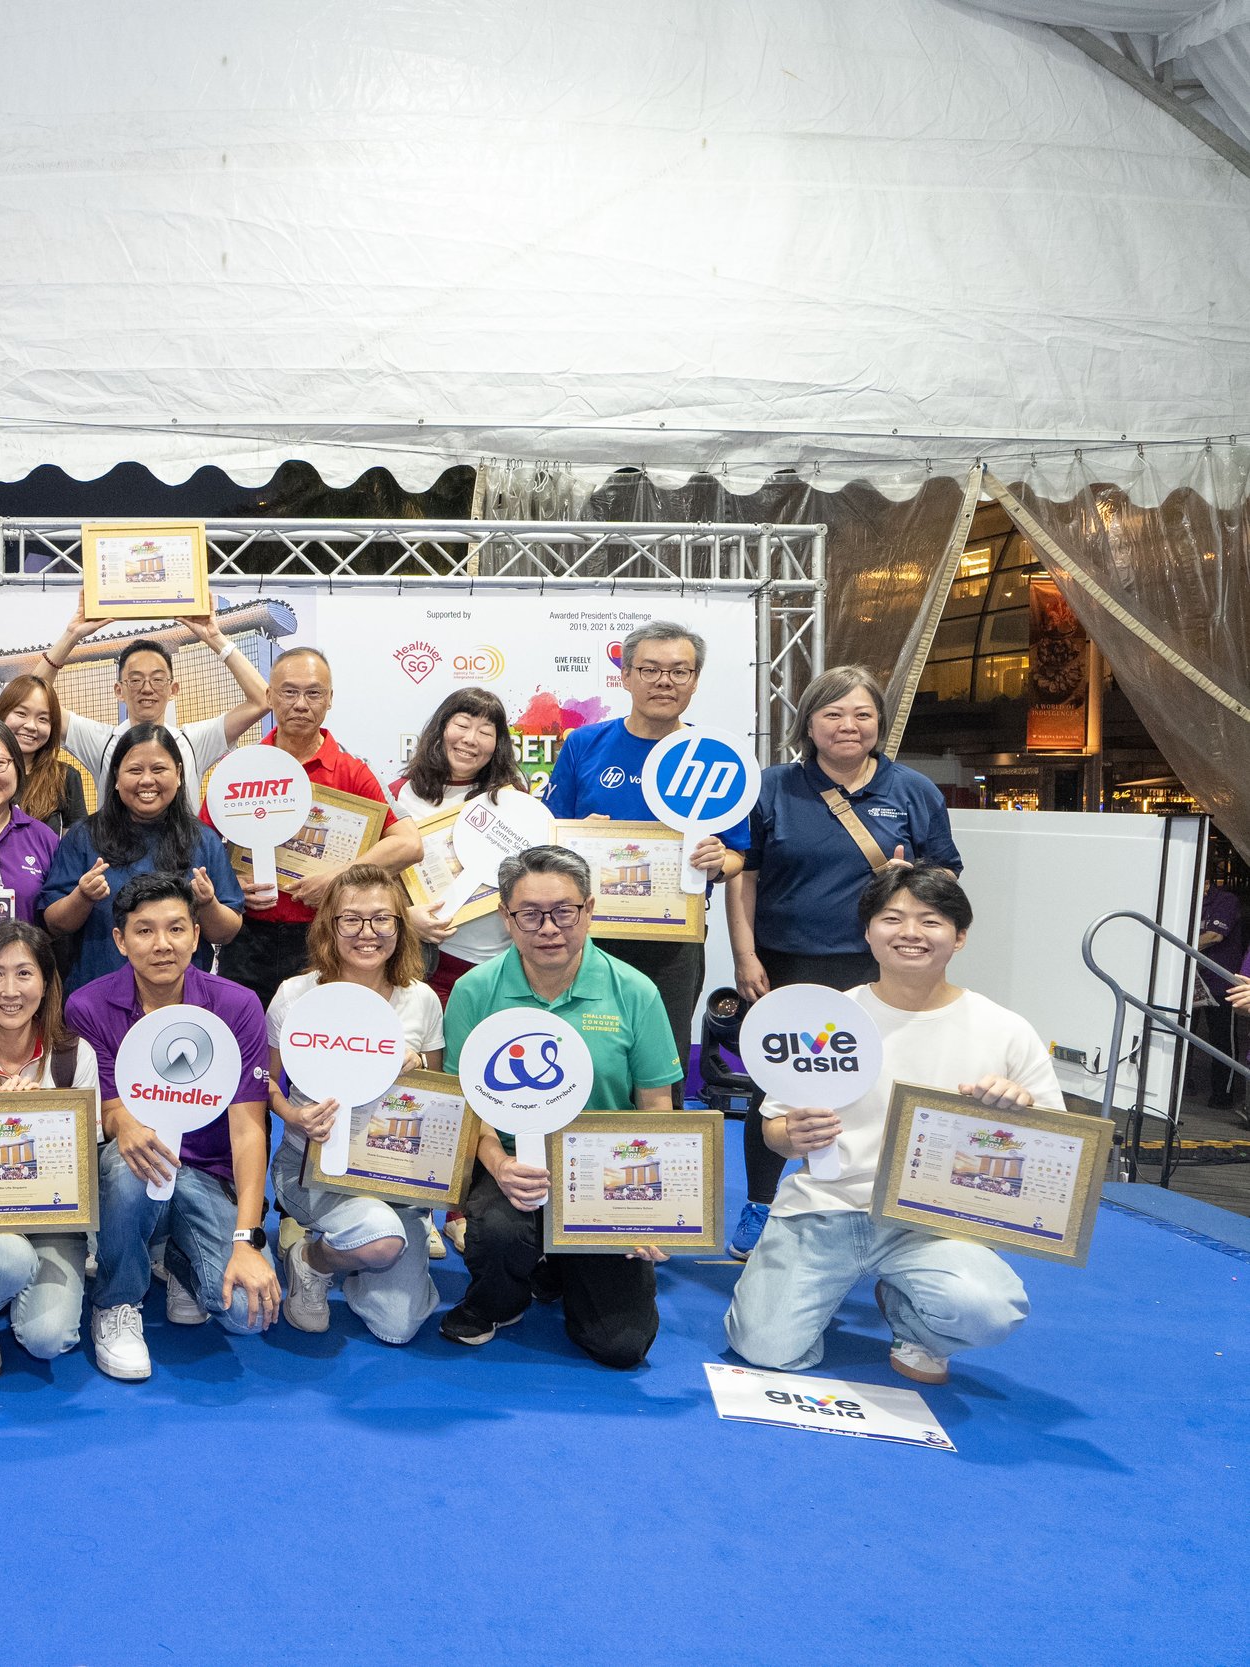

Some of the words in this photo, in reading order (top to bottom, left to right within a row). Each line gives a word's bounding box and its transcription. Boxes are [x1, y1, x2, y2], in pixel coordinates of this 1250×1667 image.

[426, 610, 461, 619] Supported
[463, 610, 471, 619] by
[619, 612, 652, 622] Challenge
[569, 623, 589, 631] 2019,
[616, 623, 635, 631] 2023
[392, 640, 443, 662] Healthier
[408, 661, 428, 672] SG
[224, 778, 294, 800] SMRT
[664, 737, 739, 820] hp
[224, 798, 296, 808] CORPORATION
[492, 826, 513, 844] Centre
[496, 820, 524, 842] National
[289, 1032, 396, 1055] ORACLE
[762, 1029, 857, 1064] give
[793, 1056, 859, 1072] asia
[130, 1083, 222, 1107] Schindler
[546, 1083, 577, 1106] Contribute
[765, 1390, 861, 1411] give
[797, 1404, 866, 1420] asia
